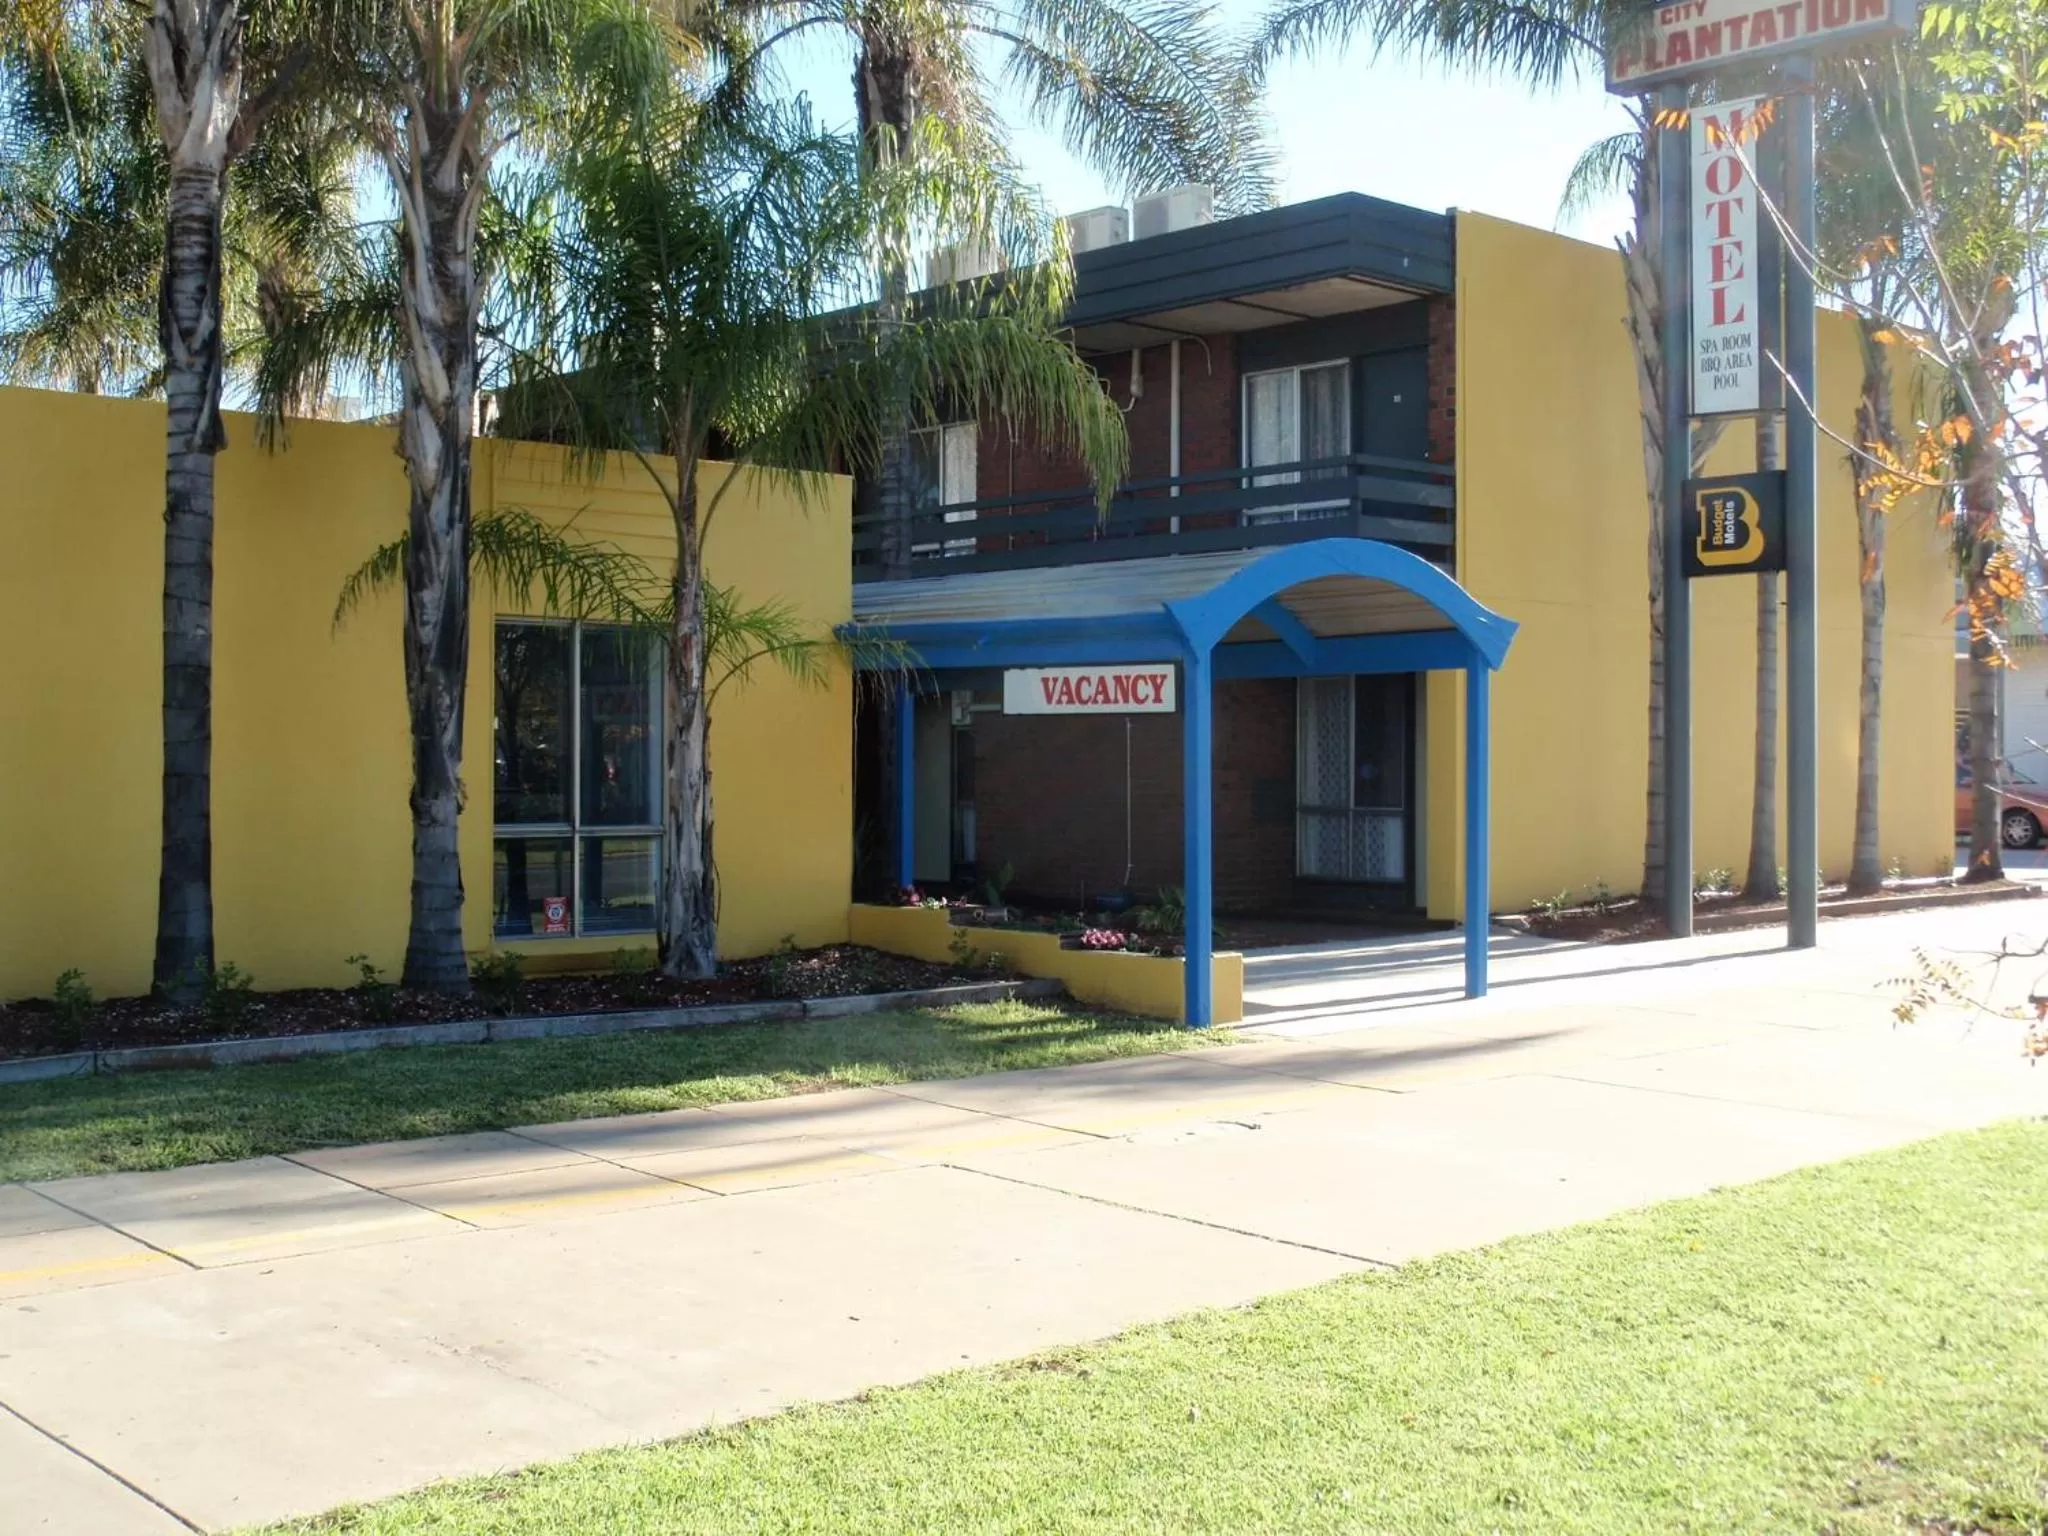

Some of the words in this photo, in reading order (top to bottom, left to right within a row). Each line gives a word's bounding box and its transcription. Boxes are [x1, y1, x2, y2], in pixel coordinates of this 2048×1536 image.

[1660, 0, 1707, 25] CITY
[1614, 0, 1887, 79] PLANTATION
[1700, 106, 1746, 328] MOTEL
[1700, 338, 1718, 353] SPA
[1721, 332, 1751, 351] ROOM
[1700, 356, 1721, 373] BBQ
[1724, 352, 1752, 371] AREA
[1713, 372, 1739, 390] POOL
[1724, 500, 1735, 544] Motels
[1040, 673, 1168, 706] VACANCY
